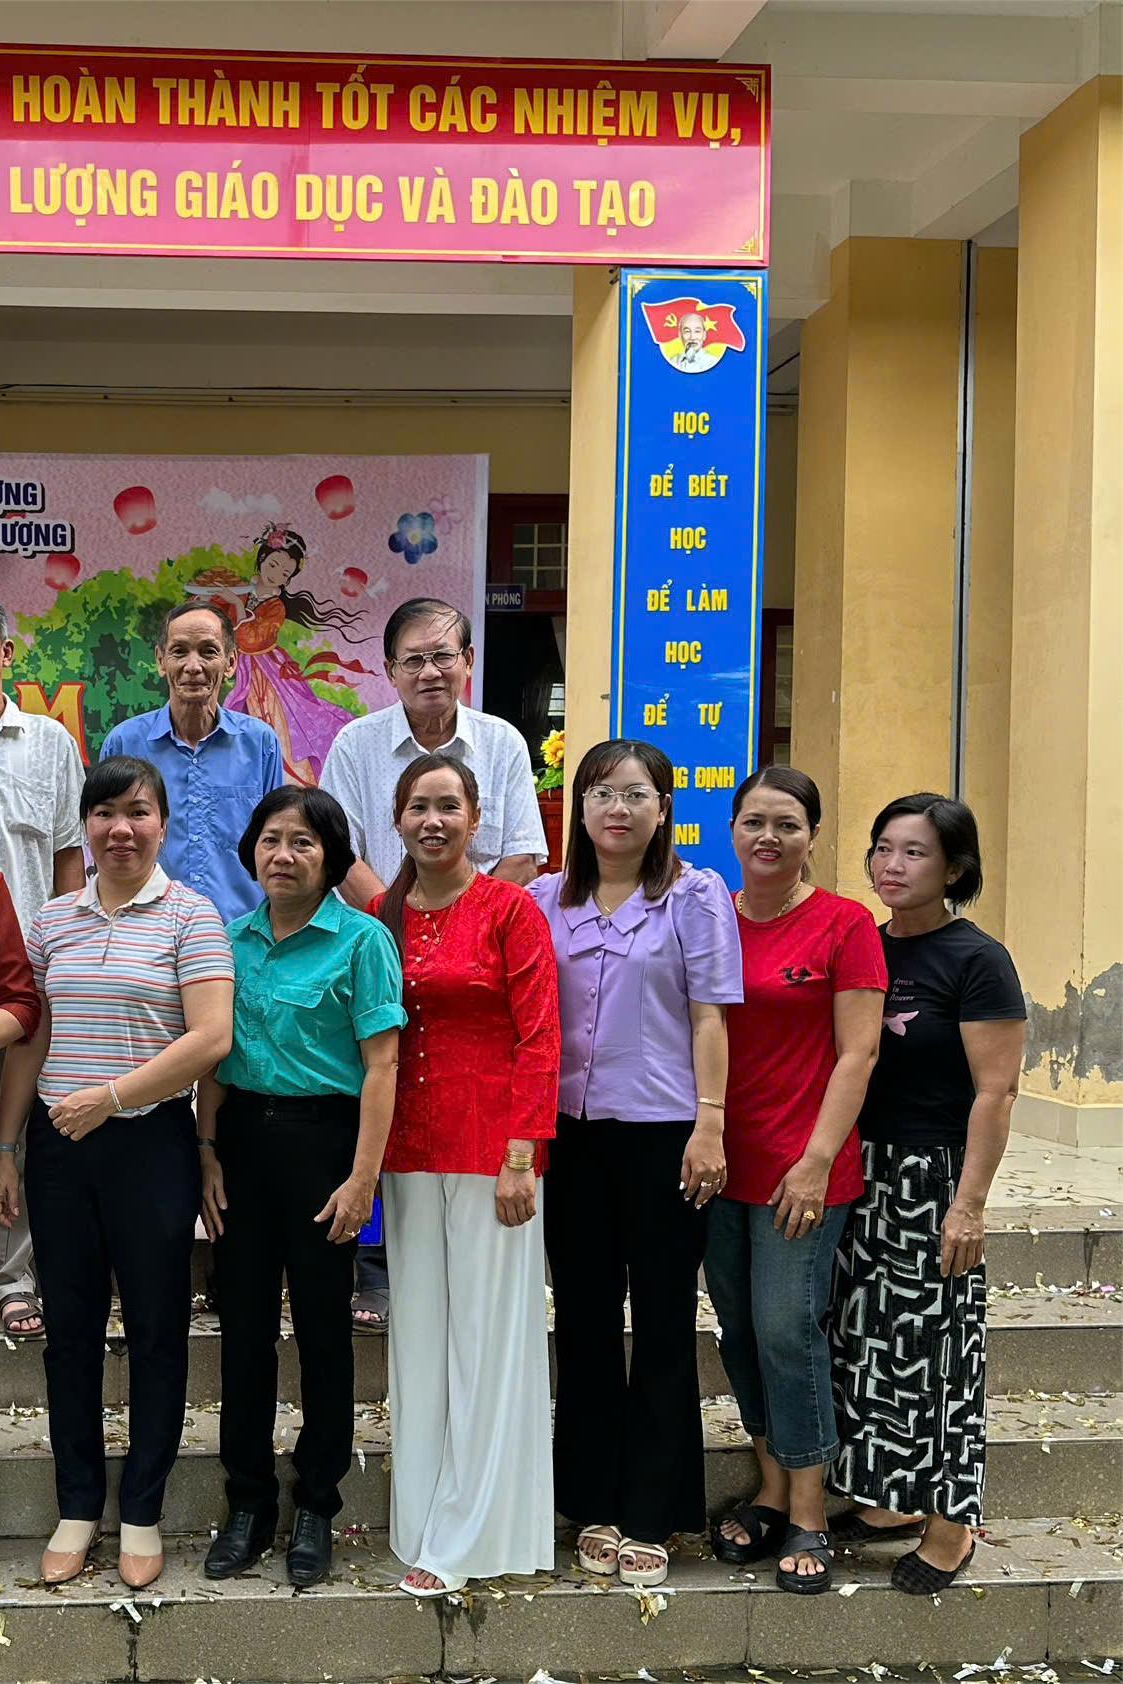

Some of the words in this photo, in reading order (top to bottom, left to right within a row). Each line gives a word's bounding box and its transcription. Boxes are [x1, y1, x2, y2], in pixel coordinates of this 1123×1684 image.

[13, 67, 135, 124] HOÀN
[153, 70, 300, 129] THÀNH
[316, 64, 395, 130] TỐT
[409, 75, 497, 133] CÁC
[514, 80, 658, 146] NHIỆM
[673, 91, 742, 149] VỤ,
[10, 162, 157, 226] LƯỢNG
[175, 160, 279, 220] GIÁO
[296, 175, 383, 232] DỤC
[399, 167, 459, 224] VÀ
[470, 168, 557, 225] ĐÀO
[574, 180, 655, 236] TẠO
[673, 412, 709, 439] HỌC
[650, 463, 674, 496] ĐỂ
[689, 467, 728, 496] BIẾT
[670, 527, 706, 554] HỌC
[647, 579, 672, 611] ĐỂ
[686, 584, 727, 611] LÀM
[665, 641, 702, 669] HỌC
[644, 693, 670, 726] ĐỂ
[698, 701, 722, 730] TỰ
[695, 766, 734, 792] ĐỊNH
